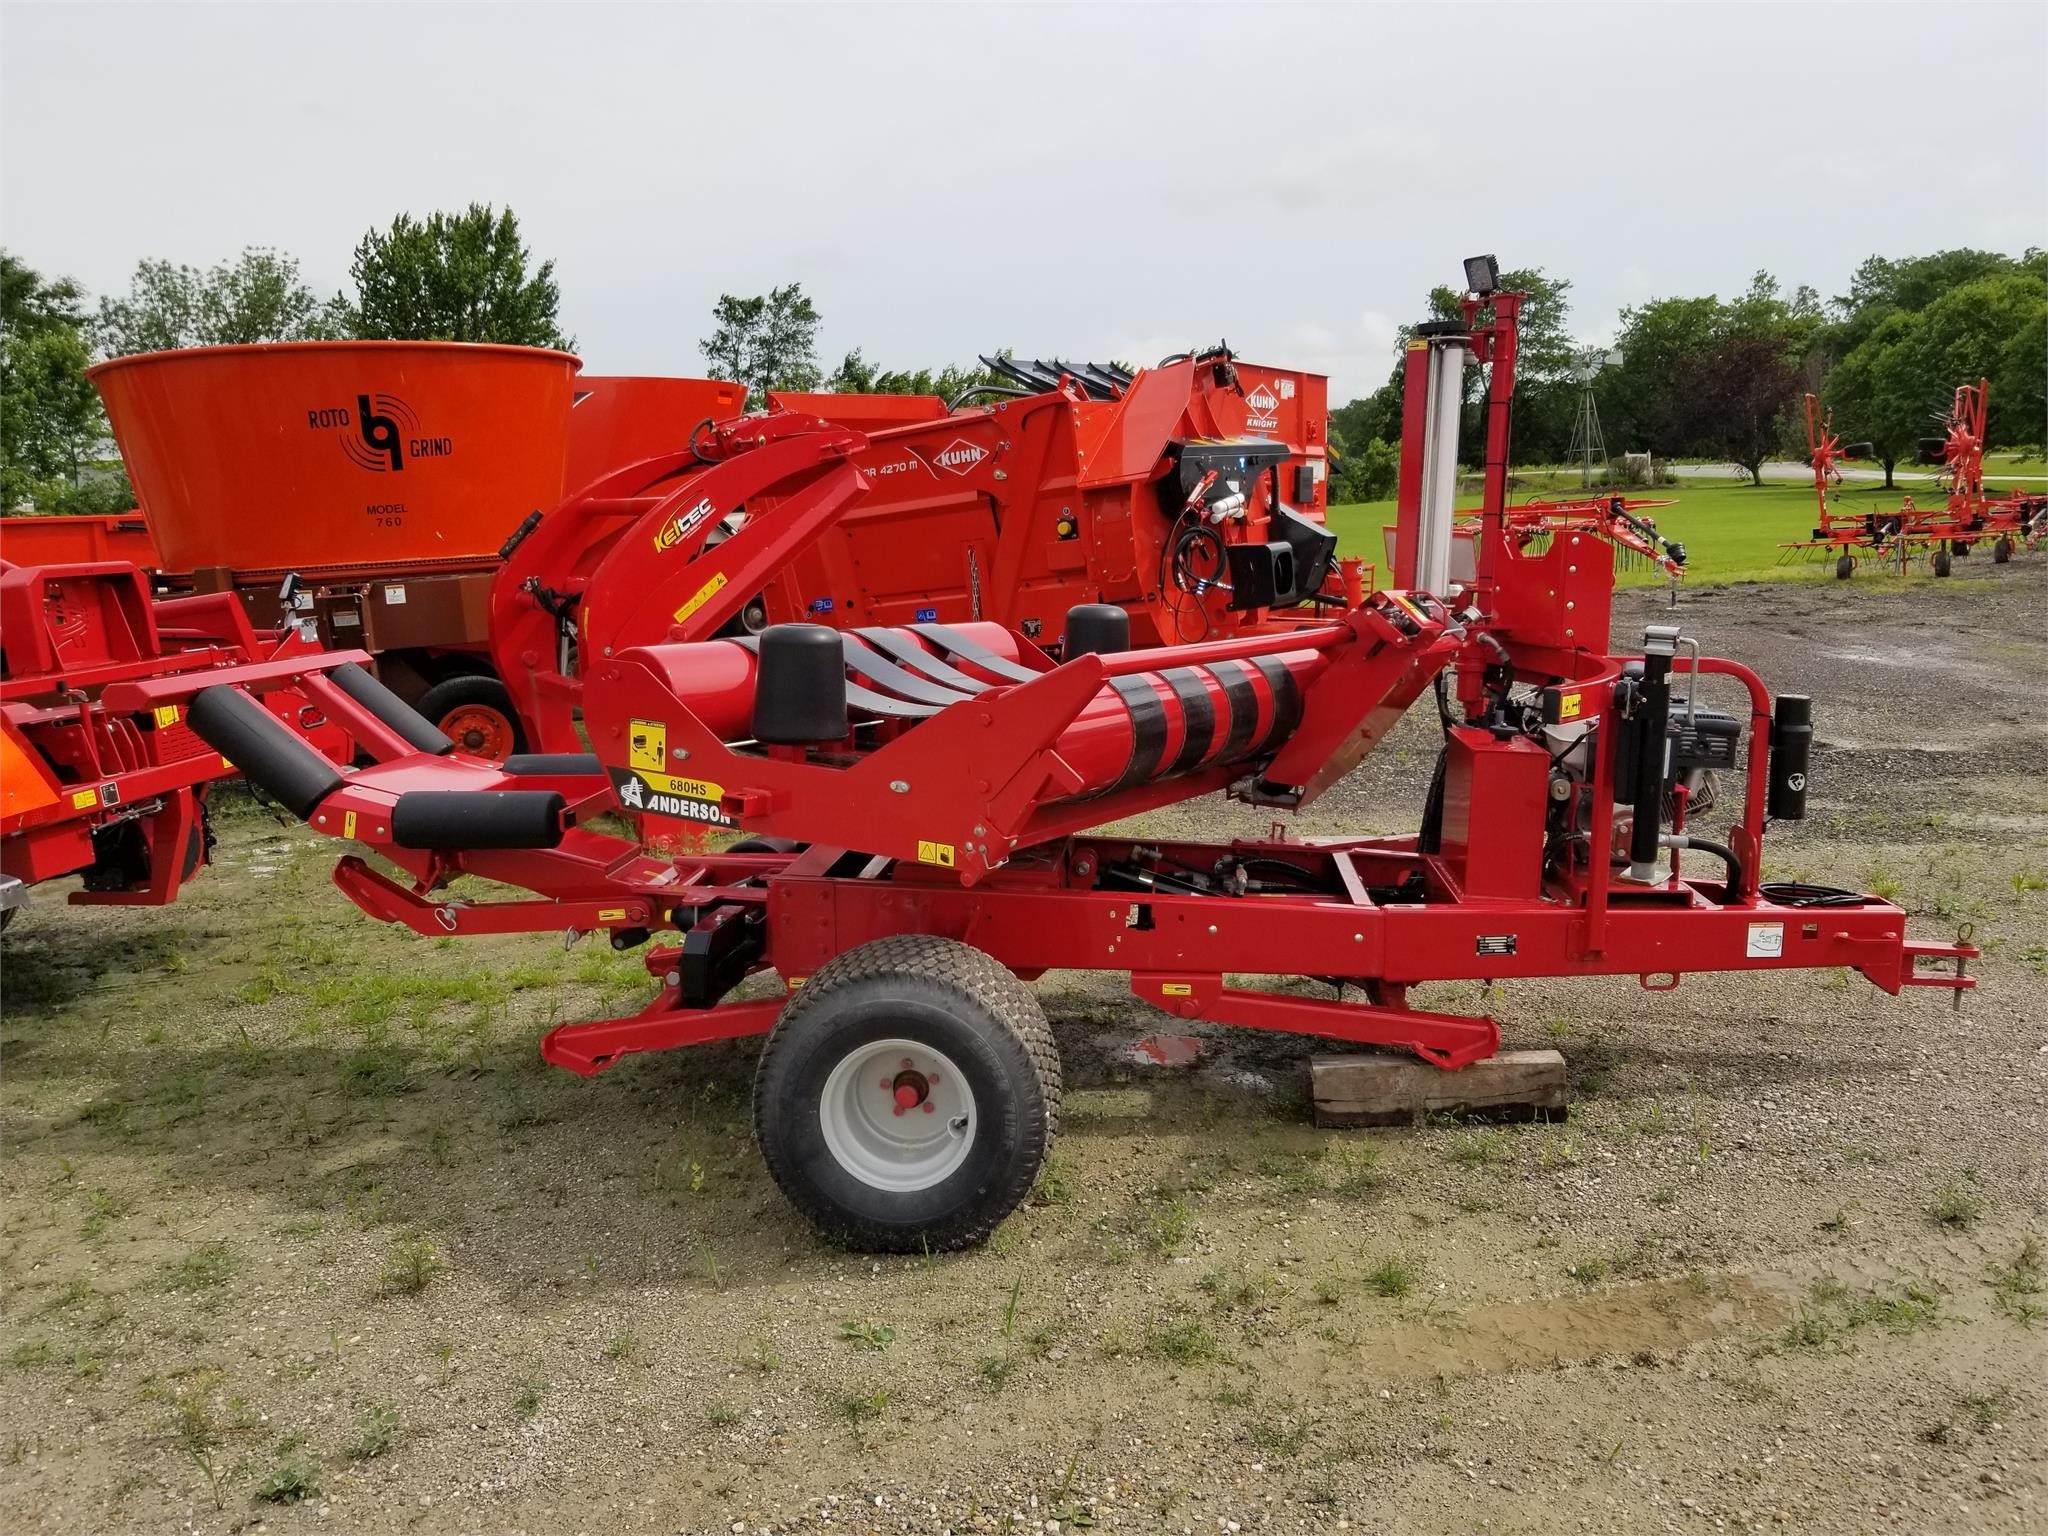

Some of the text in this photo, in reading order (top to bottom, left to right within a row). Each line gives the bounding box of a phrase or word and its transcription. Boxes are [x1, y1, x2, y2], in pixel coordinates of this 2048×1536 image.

[1250, 395, 1275, 409] KUHN
[308, 408, 350, 429] ROTO
[1246, 417, 1278, 429] KNIGHT
[409, 438, 453, 458] GRIND
[941, 448, 981, 466] KUHN
[879, 462, 907, 475] 4270
[366, 504, 408, 515] MODEL
[375, 517, 402, 527] 760
[670, 779, 707, 795] 680HS
